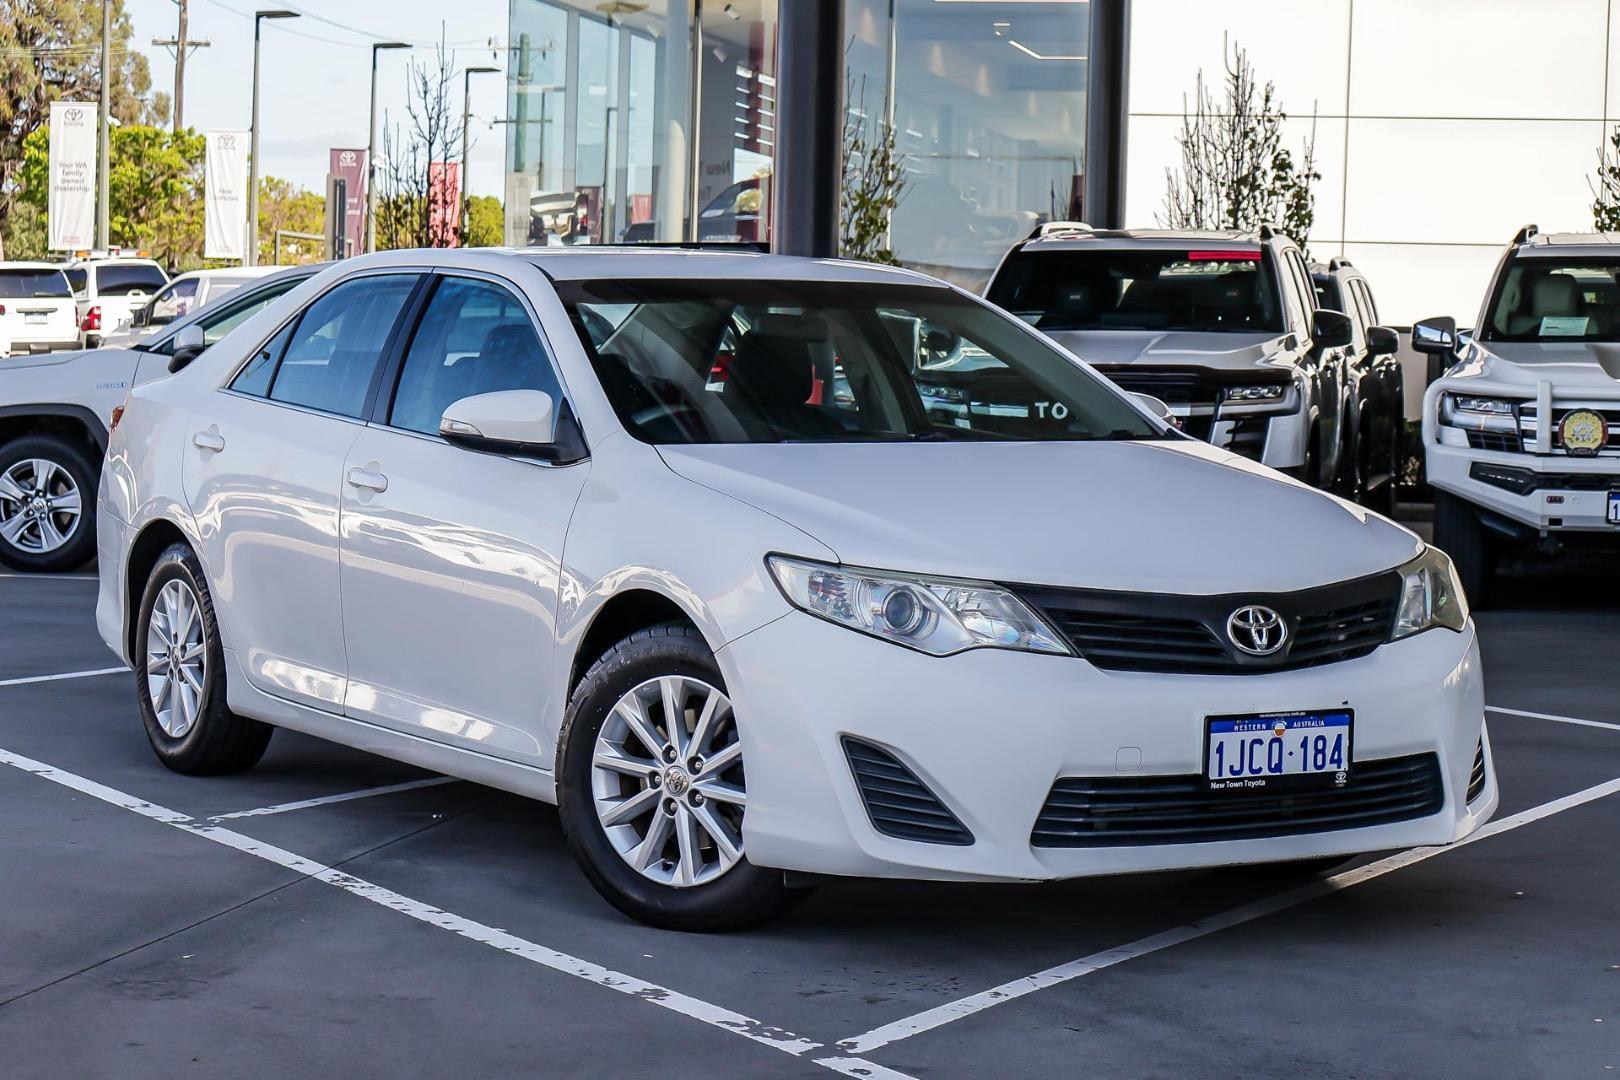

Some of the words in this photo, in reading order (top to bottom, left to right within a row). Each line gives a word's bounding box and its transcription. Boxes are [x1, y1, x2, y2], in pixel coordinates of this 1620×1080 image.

[62, 169, 83, 177] family
[1234, 723, 1267, 731] WESTERN
[1293, 720, 1325, 728] AUSTRALIA
[1210, 781, 1225, 790] New
[1225, 780, 1243, 788] Town
[1243, 779, 1266, 789] Toyota
